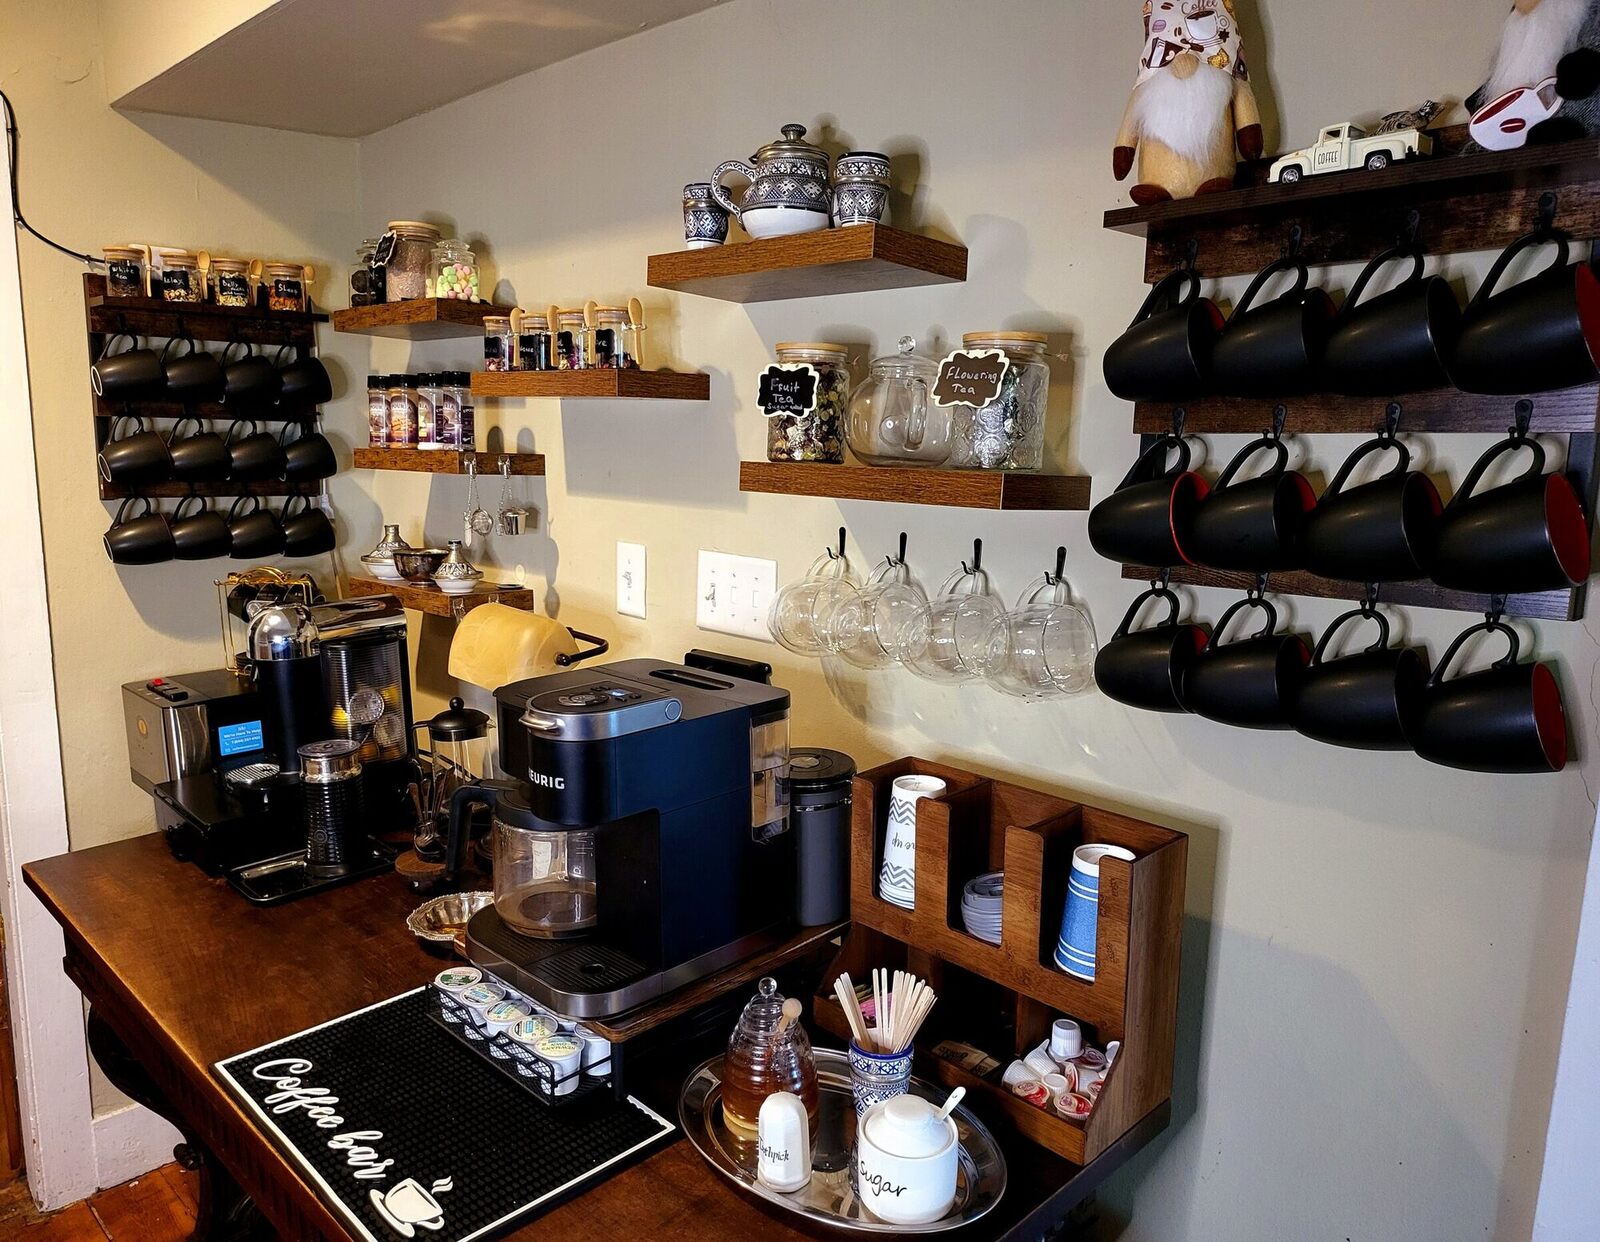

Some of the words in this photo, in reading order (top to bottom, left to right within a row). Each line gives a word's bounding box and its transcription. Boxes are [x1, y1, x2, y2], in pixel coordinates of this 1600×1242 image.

[1181, 0, 1218, 15] Coffee
[1317, 150, 1338, 166] COFFEE
[111, 266, 135, 274] White
[770, 377, 800, 393] Fruit
[951, 383, 975, 395] Tea
[772, 393, 794, 404] Tea
[252, 1058, 344, 1128] Coffee
[327, 1130, 395, 1179] bar
[859, 1160, 907, 1197] Sugar
